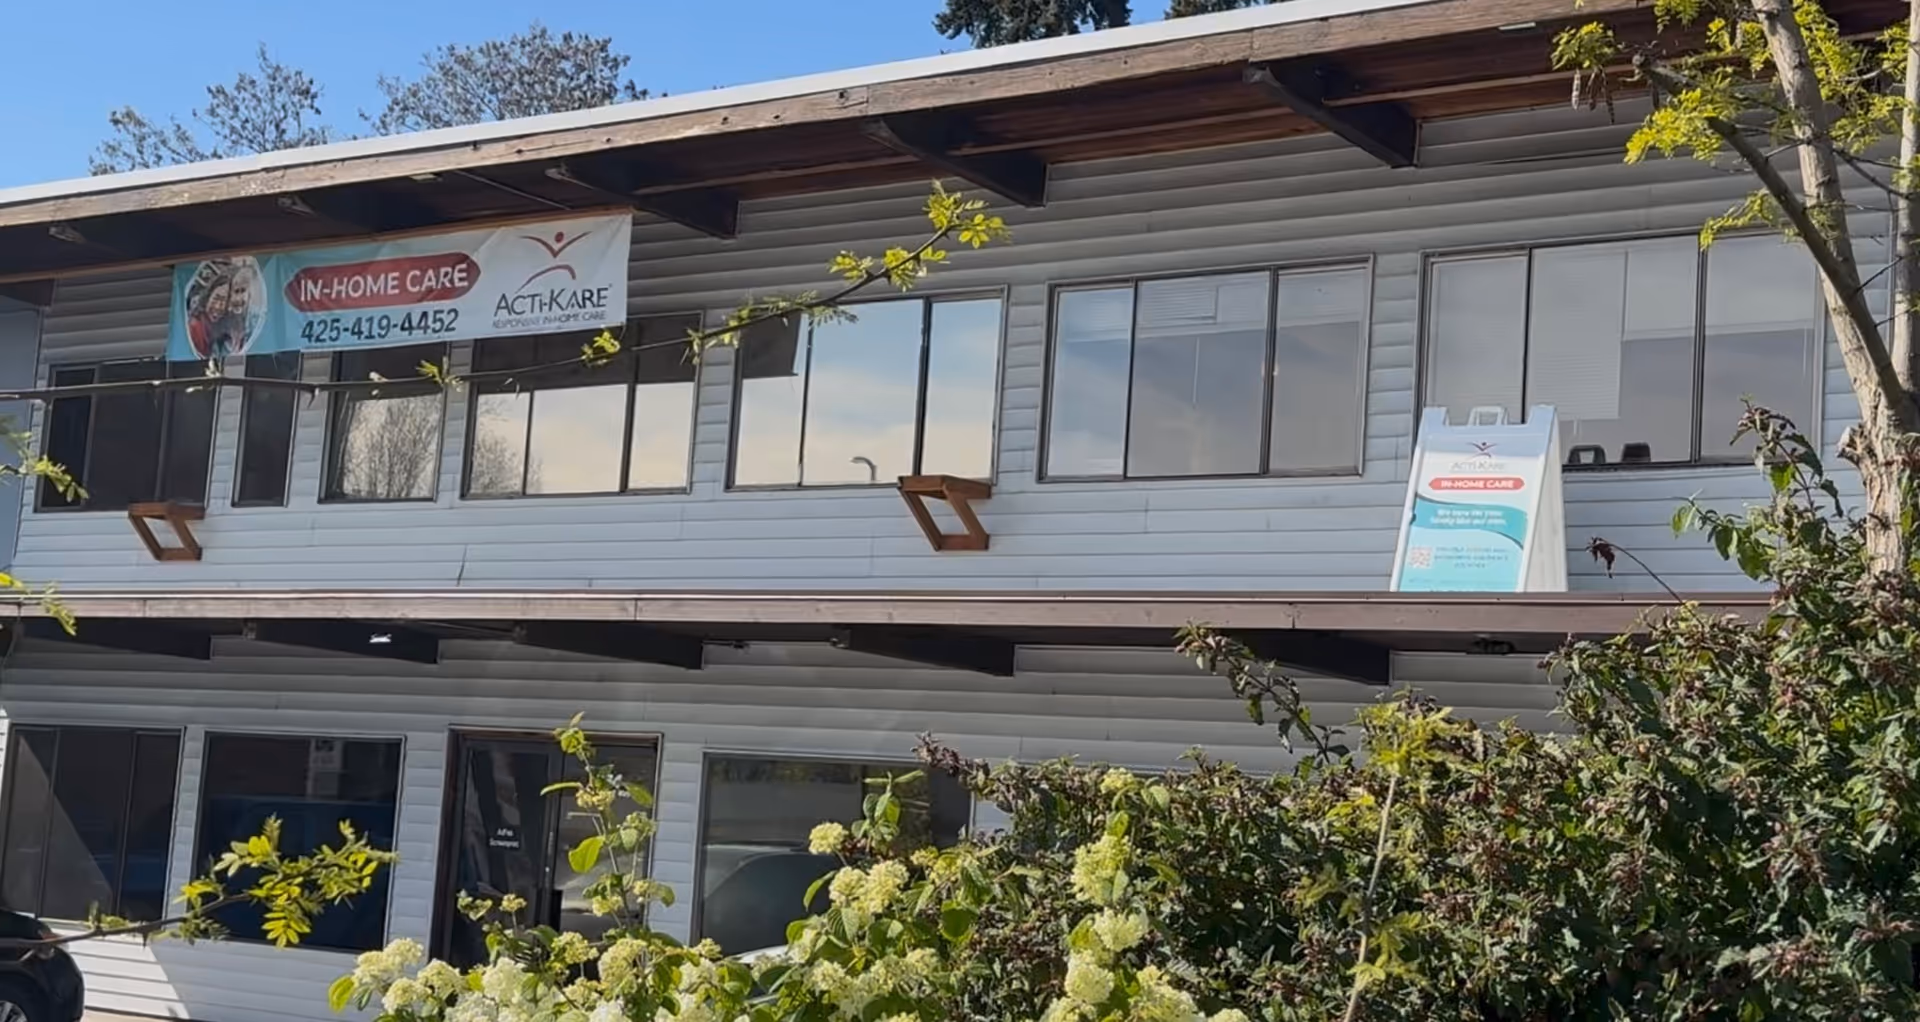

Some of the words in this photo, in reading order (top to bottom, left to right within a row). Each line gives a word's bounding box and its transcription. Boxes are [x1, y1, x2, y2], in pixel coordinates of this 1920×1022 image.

[301, 272, 400, 301] IN-HOME
[406, 263, 469, 293] CARE
[301, 308, 460, 344] 425-419-4452
[581, 310, 607, 321] CARE
[1441, 480, 1485, 489] IN-HOME
[1486, 479, 1515, 489] CARE
